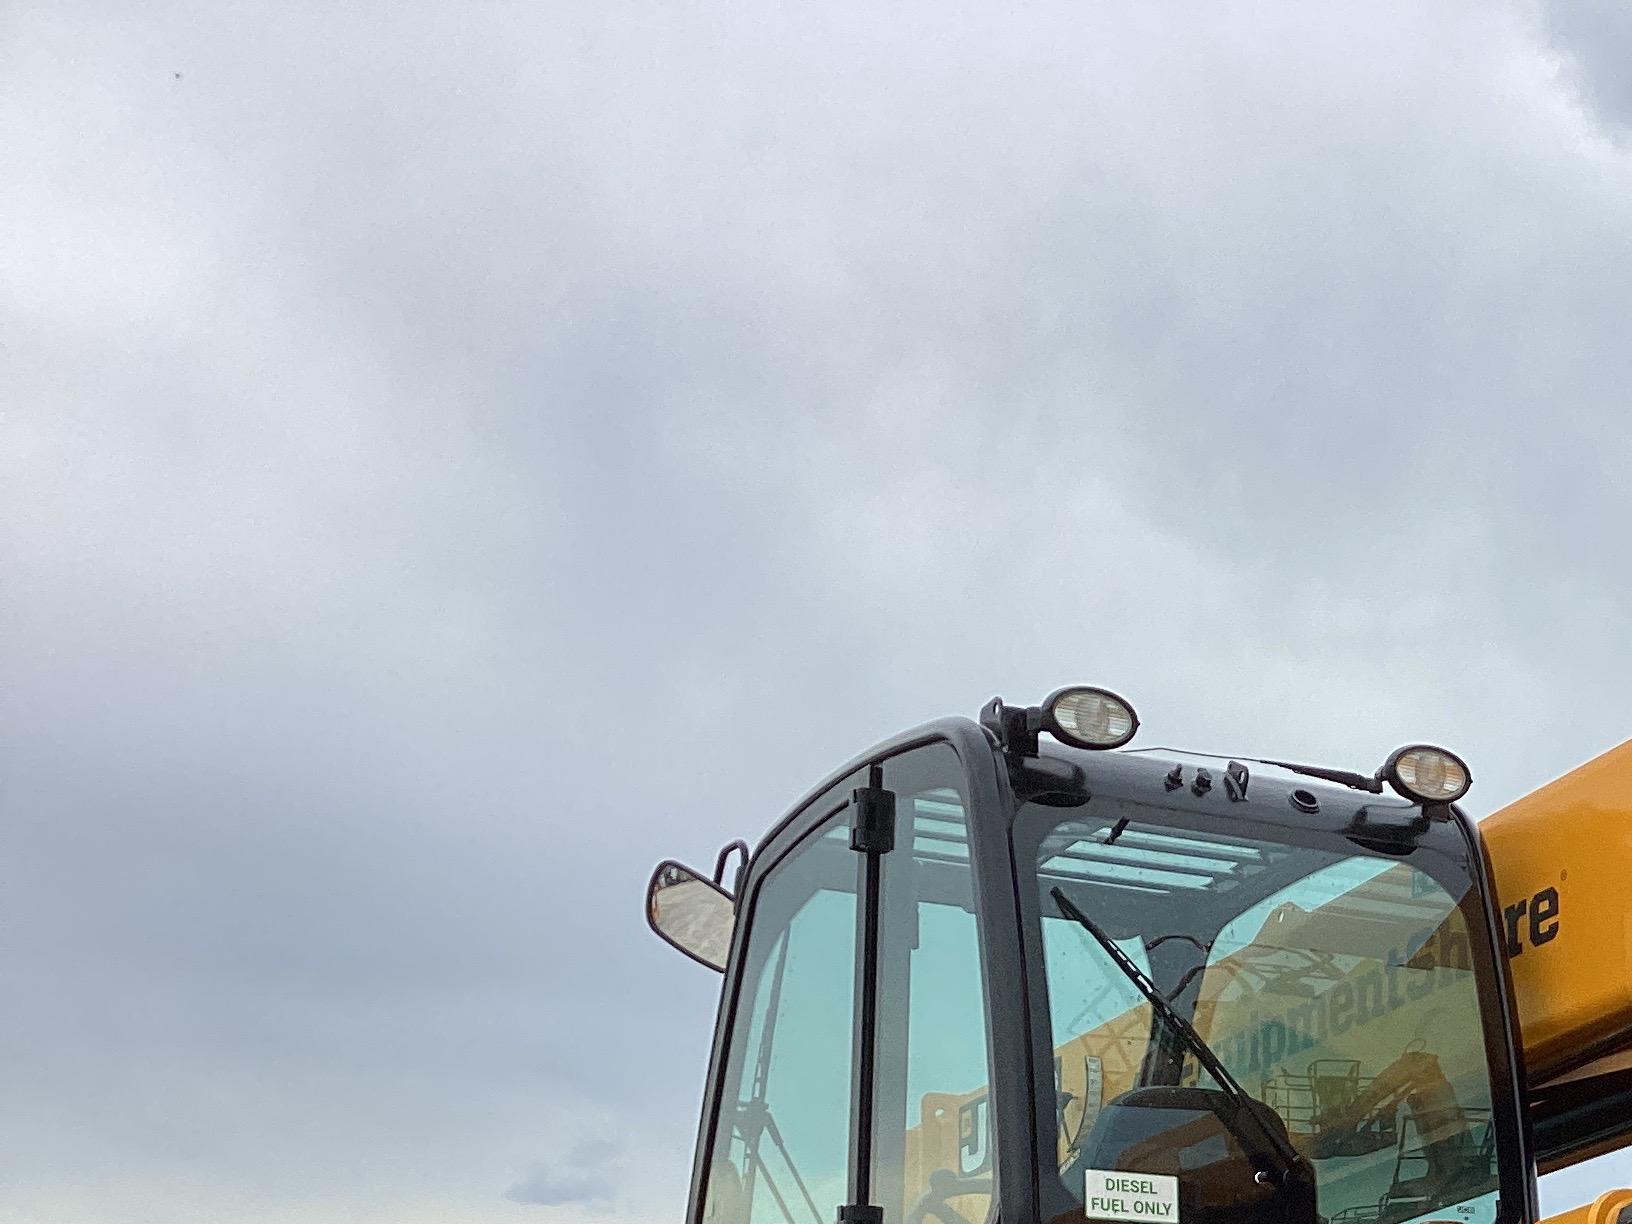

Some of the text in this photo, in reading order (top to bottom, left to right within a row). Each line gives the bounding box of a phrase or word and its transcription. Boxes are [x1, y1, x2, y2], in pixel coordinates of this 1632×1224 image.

[1104, 1177, 1158, 1195] DIESEL
[1090, 1197, 1173, 1216] FUEL ONLY
